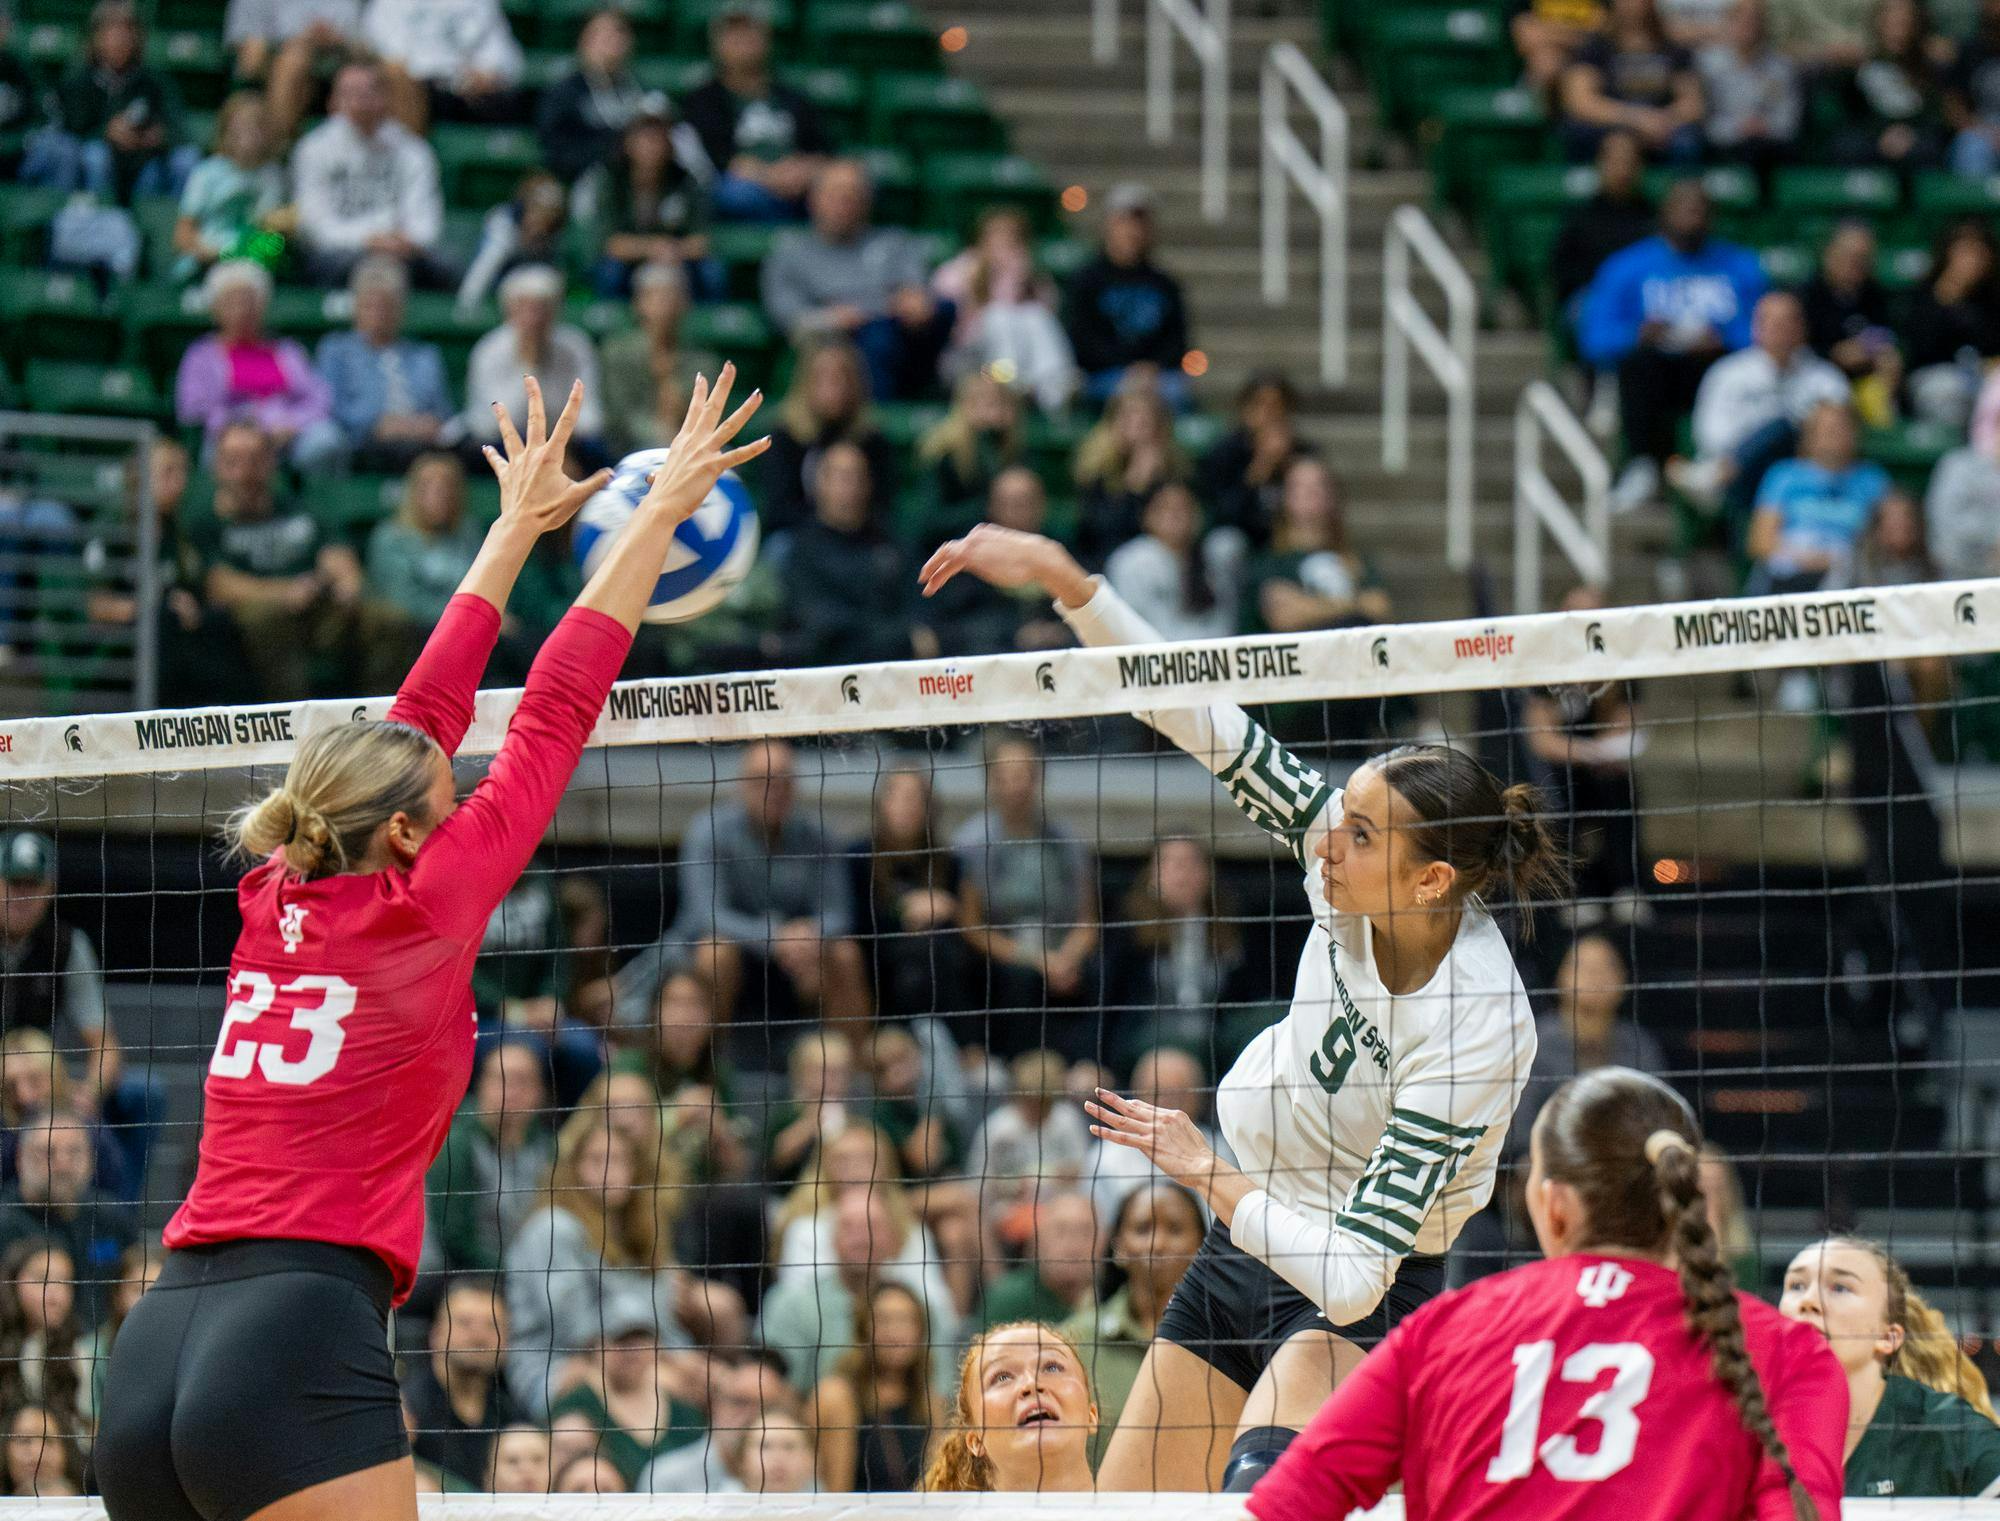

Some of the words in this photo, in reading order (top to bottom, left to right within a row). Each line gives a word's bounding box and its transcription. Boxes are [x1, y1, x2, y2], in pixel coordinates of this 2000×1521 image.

[1454, 628, 1514, 662] meijer
[1674, 604, 1799, 649] MICHIGAN
[1803, 599, 1876, 637] STATE
[918, 668, 973, 700] meijer
[1117, 648, 1231, 688] MICHIGAN
[1236, 643, 1302, 680] STATE
[609, 683, 713, 721] MICHIGAN
[717, 679, 780, 714] STATE
[134, 714, 233, 751] MICHIGAN
[234, 710, 294, 744] STATE
[209, 969, 358, 1086] 23
[1310, 1016, 1357, 1095] 9
[1485, 1338, 1656, 1484] 13
